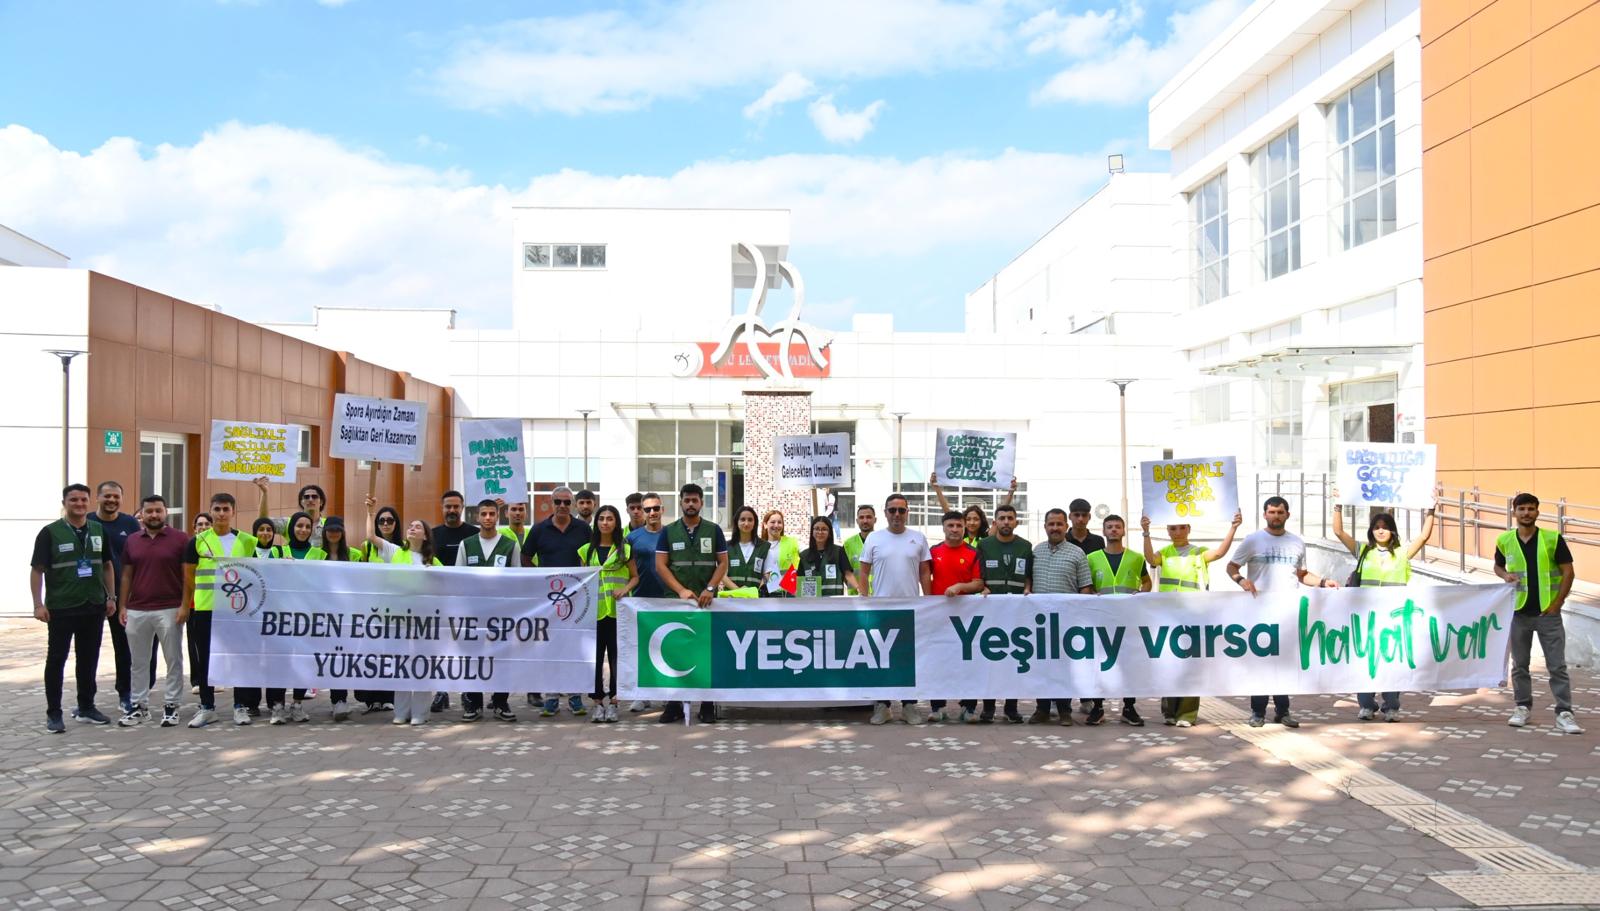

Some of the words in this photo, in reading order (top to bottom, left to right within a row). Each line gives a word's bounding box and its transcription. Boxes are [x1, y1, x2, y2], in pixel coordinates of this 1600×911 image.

[345, 402, 364, 420] Spora
[365, 404, 392, 423] Ayırdığın
[393, 406, 416, 422] Zamanı
[340, 425, 369, 443] Sağlıktan
[370, 427, 385, 443] Geri
[385, 429, 417, 445] Kazanırsın
[813, 442, 839, 458] Mutluyuz
[781, 465, 813, 479] Gelecekten
[813, 464, 842, 479] Umutluyuz
[484, 479, 507, 495] AL
[1360, 483, 1403, 503] YOK
[1175, 502, 1205, 517] OL
[261, 611, 344, 638] BEDEN
[350, 608, 440, 641] EĞİTİMİ
[449, 617, 479, 641] VE
[486, 617, 550, 642] SPOR
[949, 612, 1126, 673] Yeşilay
[1139, 623, 1280, 658] varsa
[1298, 595, 1424, 679] hayat
[1429, 612, 1502, 663] var
[726, 628, 900, 675] YEŞİLAY
[314, 646, 494, 681] YÜKSEKOKULU
